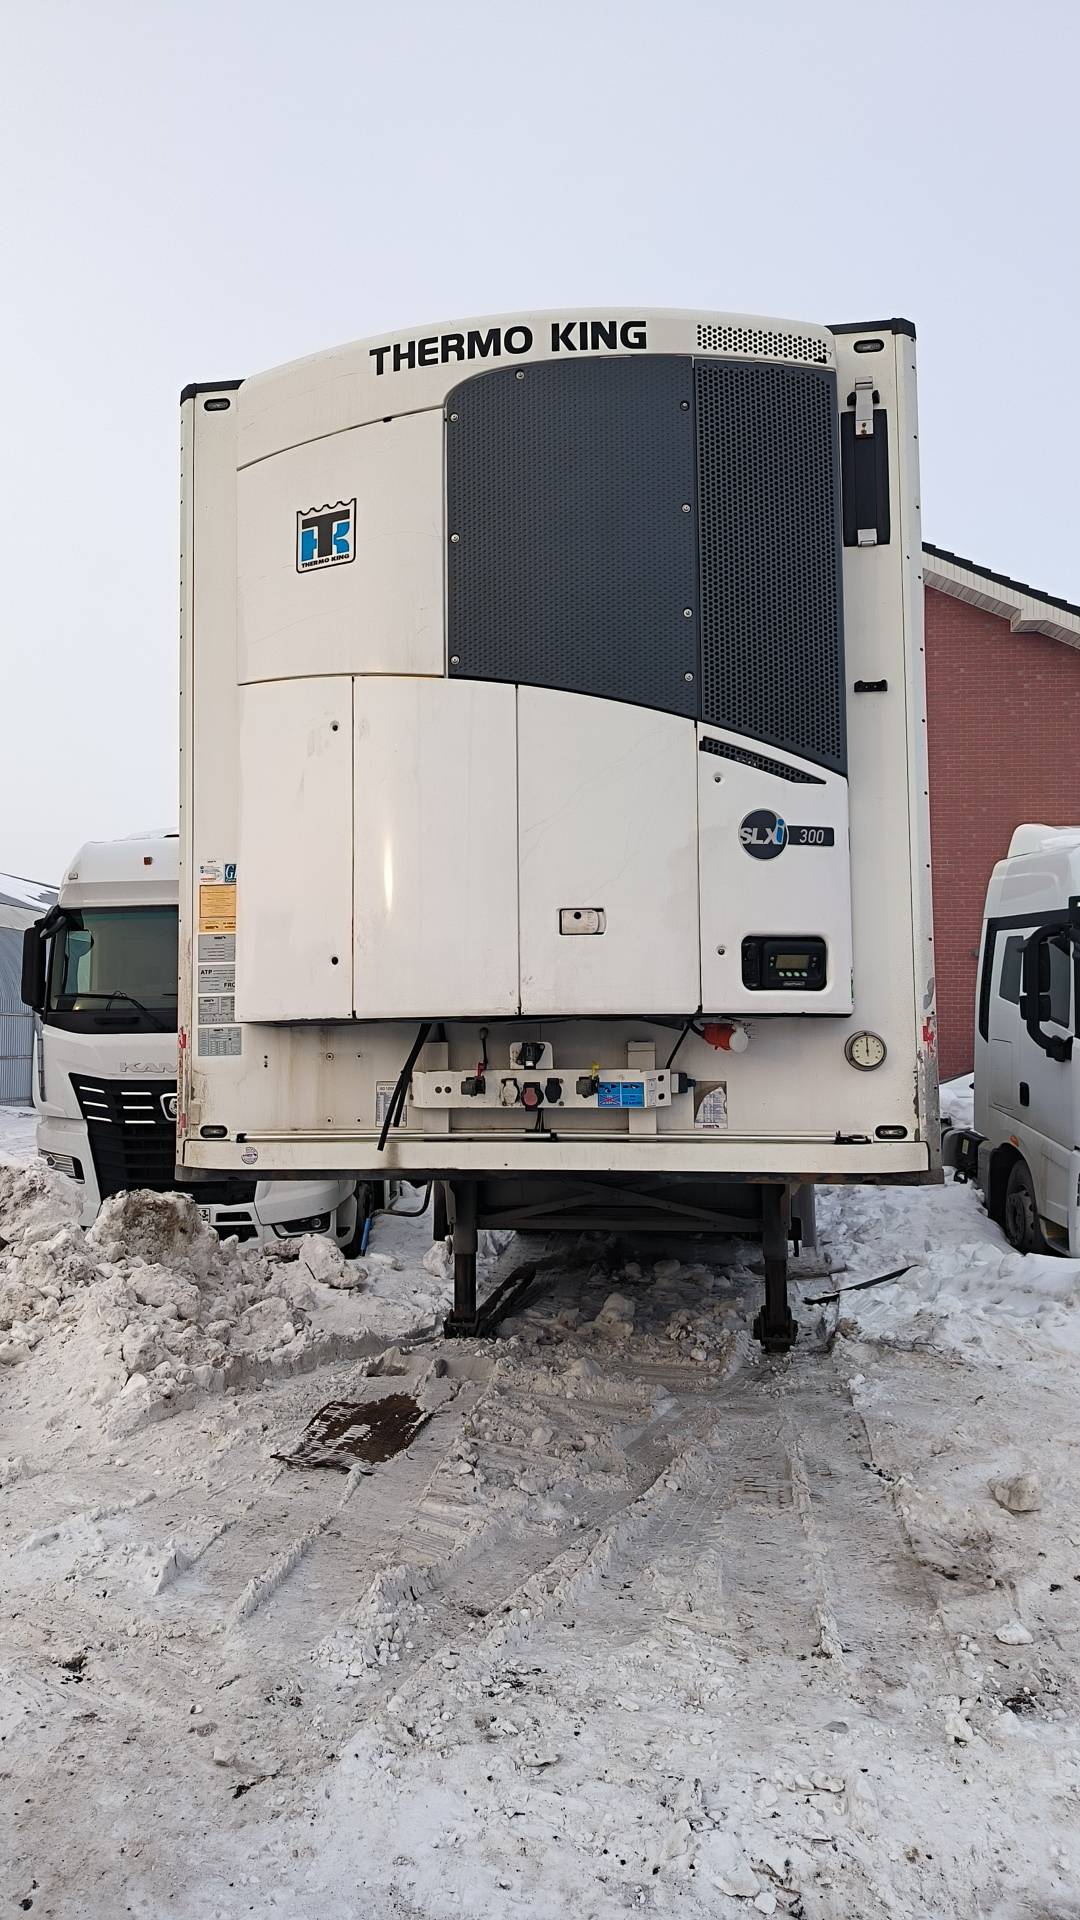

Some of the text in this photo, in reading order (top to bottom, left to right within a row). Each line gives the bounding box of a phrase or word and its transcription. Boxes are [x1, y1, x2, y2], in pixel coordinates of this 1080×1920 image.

[369, 320, 647, 376] THERMO KING
[301, 553, 350, 568] THERMO KING
[799, 829, 825, 844] 300
